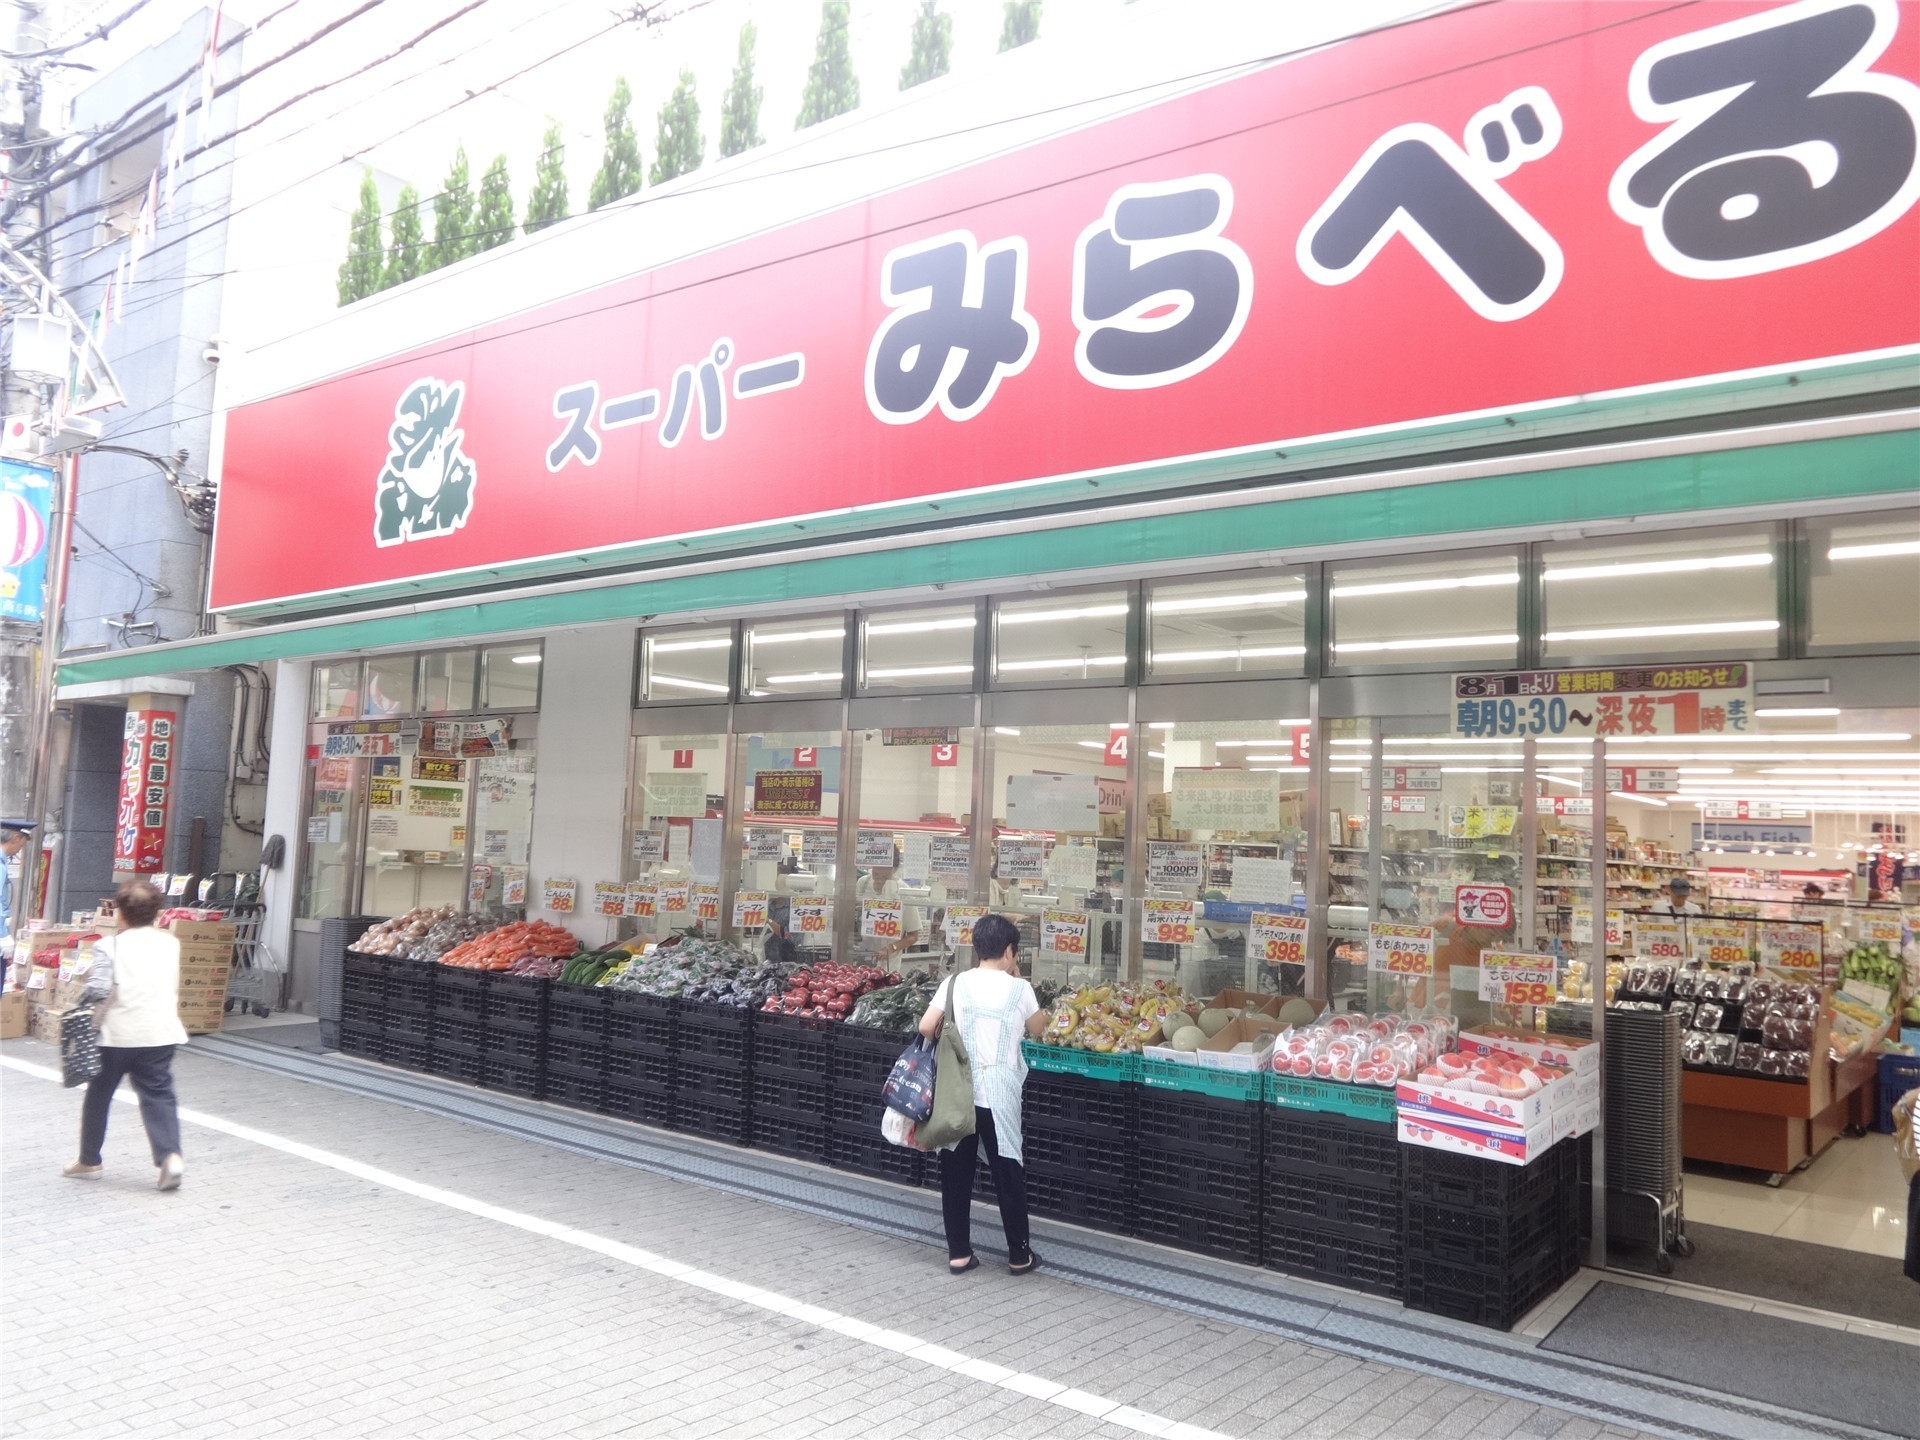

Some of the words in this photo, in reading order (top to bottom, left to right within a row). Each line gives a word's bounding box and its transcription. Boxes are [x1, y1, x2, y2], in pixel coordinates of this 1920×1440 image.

[544, 337, 806, 473] スーパー
[865, 0, 1920, 424] みらべる
[936, 744, 952, 761] 3
[1110, 736, 1128, 759] 4
[144, 718, 169, 828] 地域最安値
[1396, 774, 1406, 784] 3
[1625, 774, 1633, 786] 1
[118, 735, 142, 854] カラオケ
[1393, 800, 1400, 808] 6
[1555, 802, 1563, 811] 4
[1738, 801, 1748, 814] 2
[1467, 807, 1480, 819] 米
[1499, 807, 1513, 819] 米
[1162, 865, 1199, 874] 1000円
[545, 890, 572, 898] にんじん
[661, 890, 686, 898] ゴーヤ
[601, 901, 625, 917] 158
[736, 903, 765, 912] ピーマン
[793, 908, 824, 917] なす
[865, 911, 899, 921] トマト
[1147, 913, 1192, 924] 南米バナナ
[1252, 913, 1306, 929] 特大!!
[950, 919, 970, 927] きゅうり
[1045, 924, 1084, 936] きゅうり
[1157, 923, 1195, 943] 98円
[1054, 934, 1085, 954] 158円
[1375, 939, 1430, 953] もも(あかつき)
[1265, 940, 1306, 964] 398円
[1387, 950, 1432, 974] 298円
[1489, 969, 1552, 983] もも(くにか)
[1504, 982, 1556, 1006] 158円
